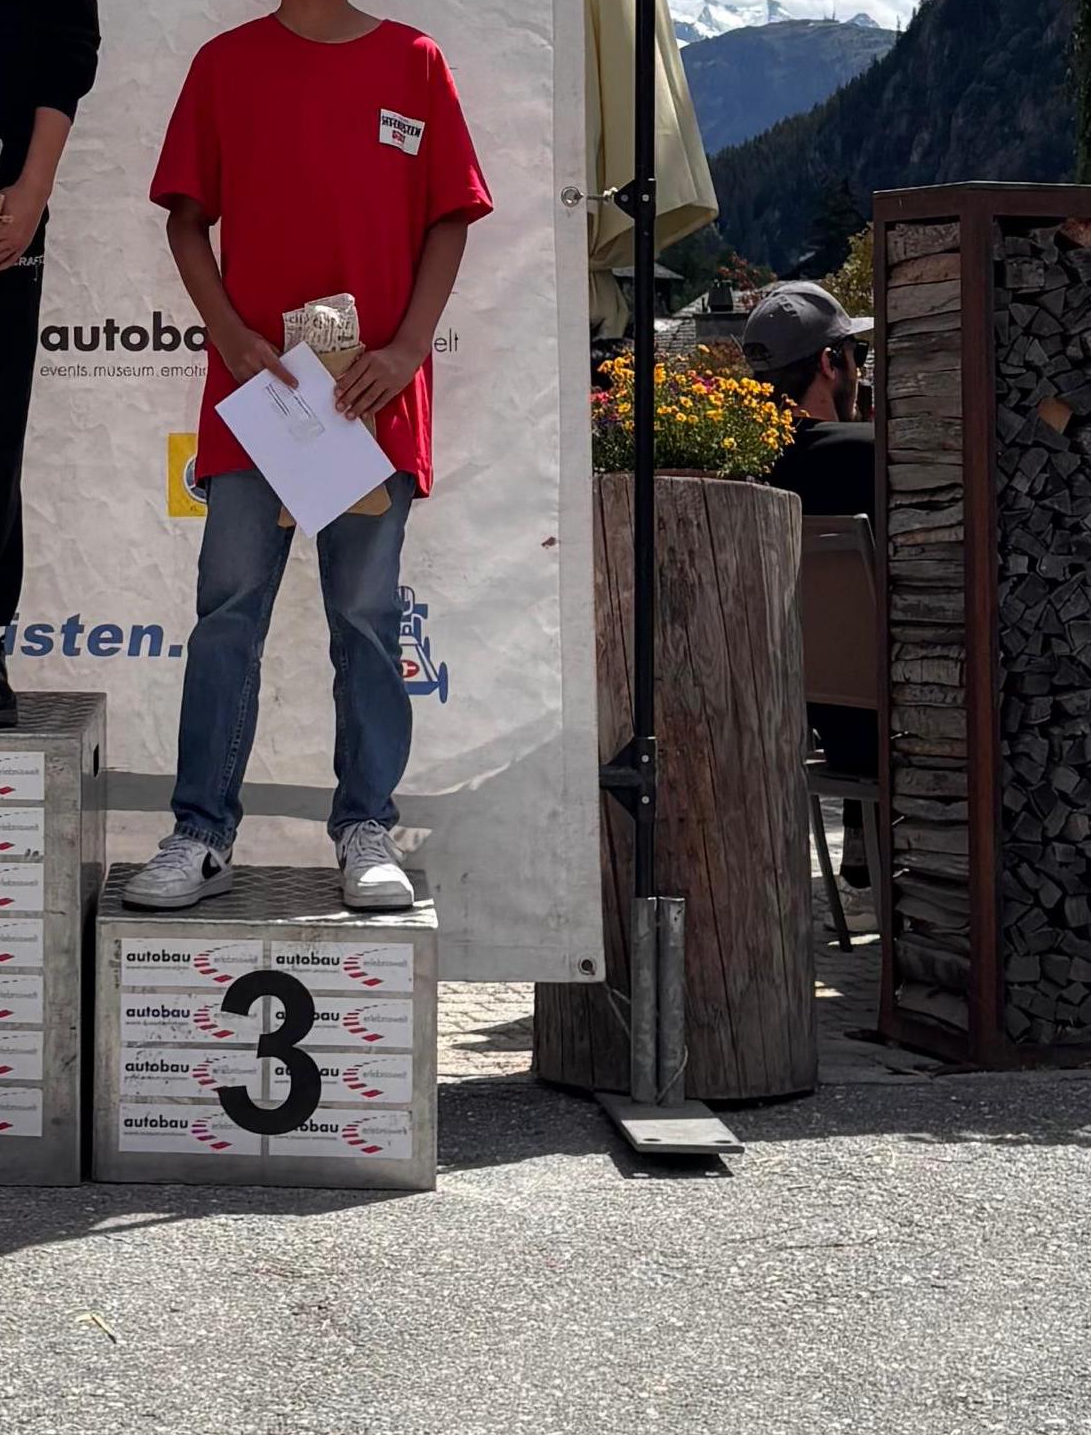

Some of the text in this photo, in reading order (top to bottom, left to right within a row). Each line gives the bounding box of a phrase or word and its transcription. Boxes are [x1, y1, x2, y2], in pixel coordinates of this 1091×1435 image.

[126, 950, 191, 963] autobau
[276, 952, 340, 965] autobau
[126, 1005, 190, 1018] autobau
[217, 969, 322, 1136] 3
[125, 1060, 189, 1073] autobau
[124, 1115, 188, 1129] autobau
[295, 1119, 339, 1132] obau
